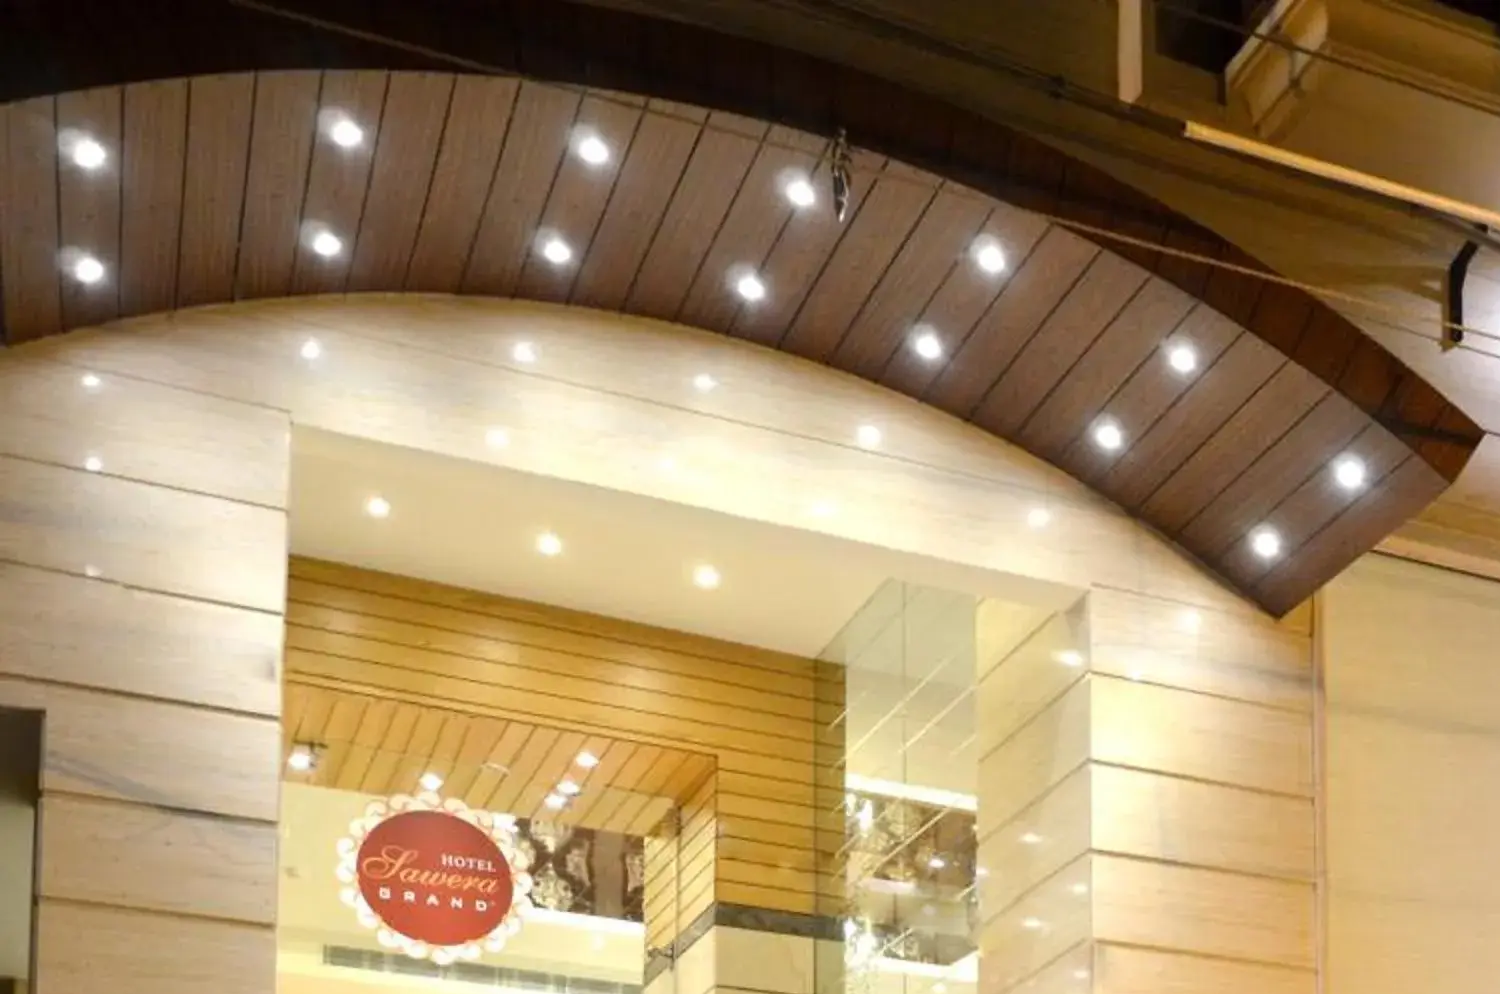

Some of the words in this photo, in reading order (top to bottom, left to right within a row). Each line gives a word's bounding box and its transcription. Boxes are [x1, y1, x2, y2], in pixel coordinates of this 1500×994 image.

[362, 845, 499, 893] Sawera
[441, 854, 497, 873] HOTEL
[379, 886, 488, 912] GRAND
